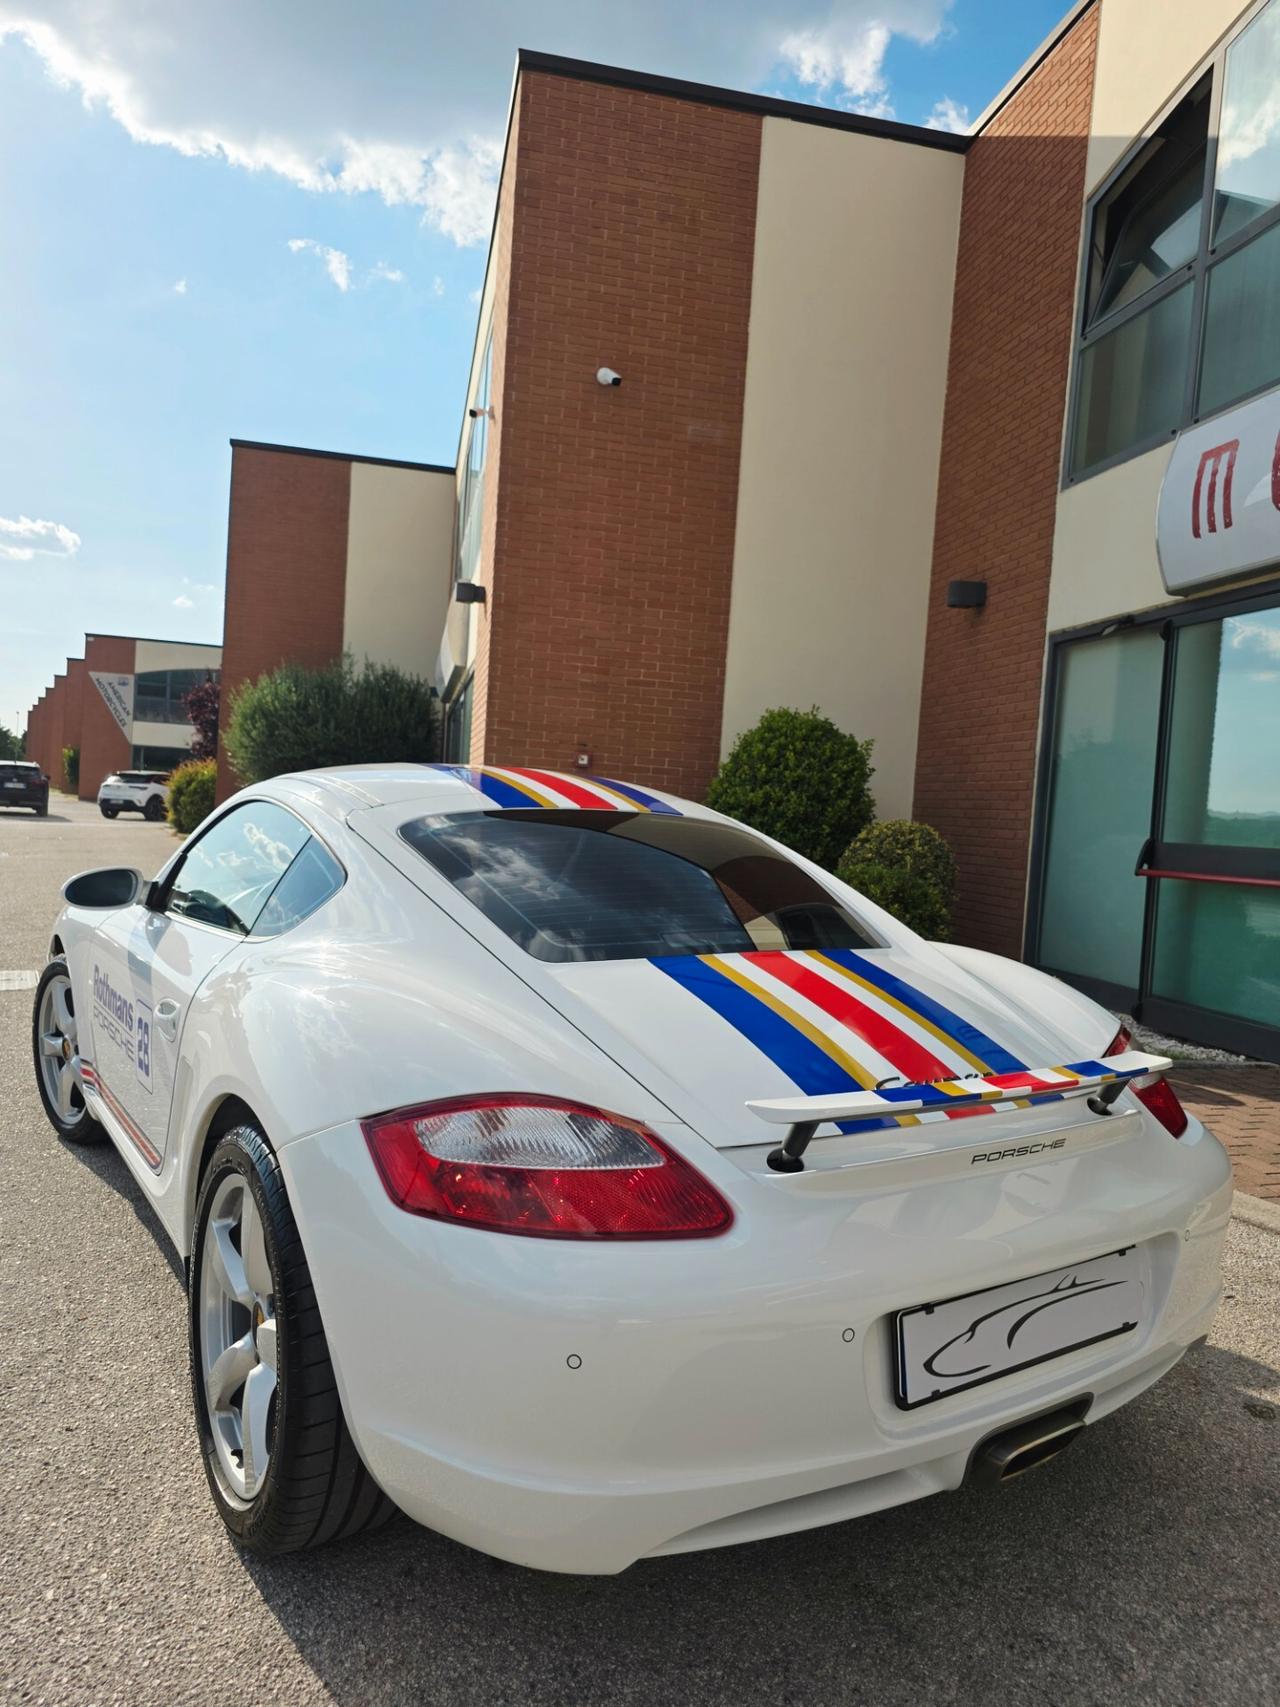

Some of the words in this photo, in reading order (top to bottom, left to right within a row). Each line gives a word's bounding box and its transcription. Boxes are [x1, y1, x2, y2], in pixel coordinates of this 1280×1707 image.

[1192, 428, 1280, 539] M
[108, 682, 130, 716] AMERICAN
[93, 964, 134, 1032] Rothmans
[93, 1006, 136, 1063] PORSCHE
[970, 1138, 1067, 1165] PORSCHE
